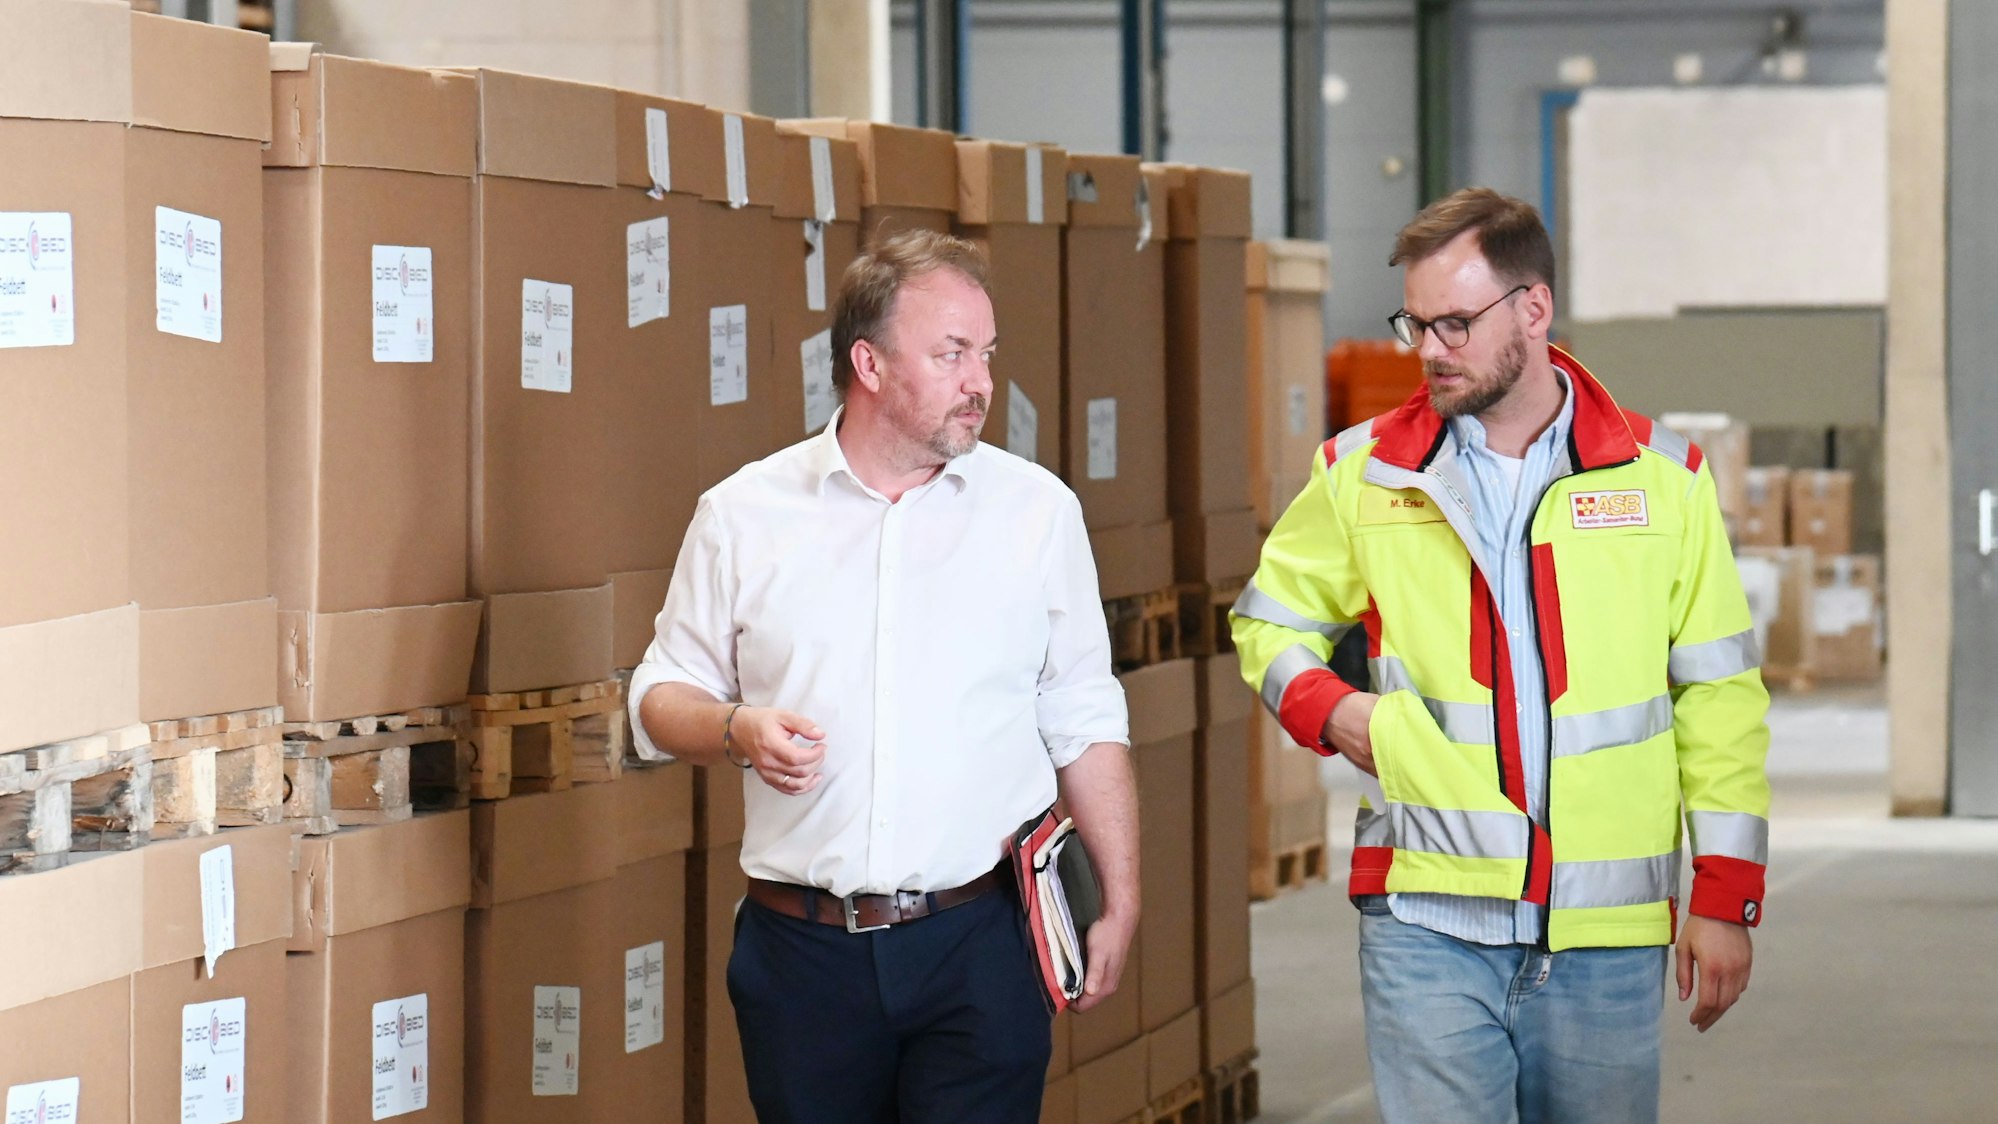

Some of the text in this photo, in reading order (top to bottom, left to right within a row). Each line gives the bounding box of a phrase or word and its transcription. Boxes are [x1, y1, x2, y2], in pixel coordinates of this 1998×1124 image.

[1390, 499, 1425, 508] M. Erke
[1592, 494, 1642, 516] ASB
